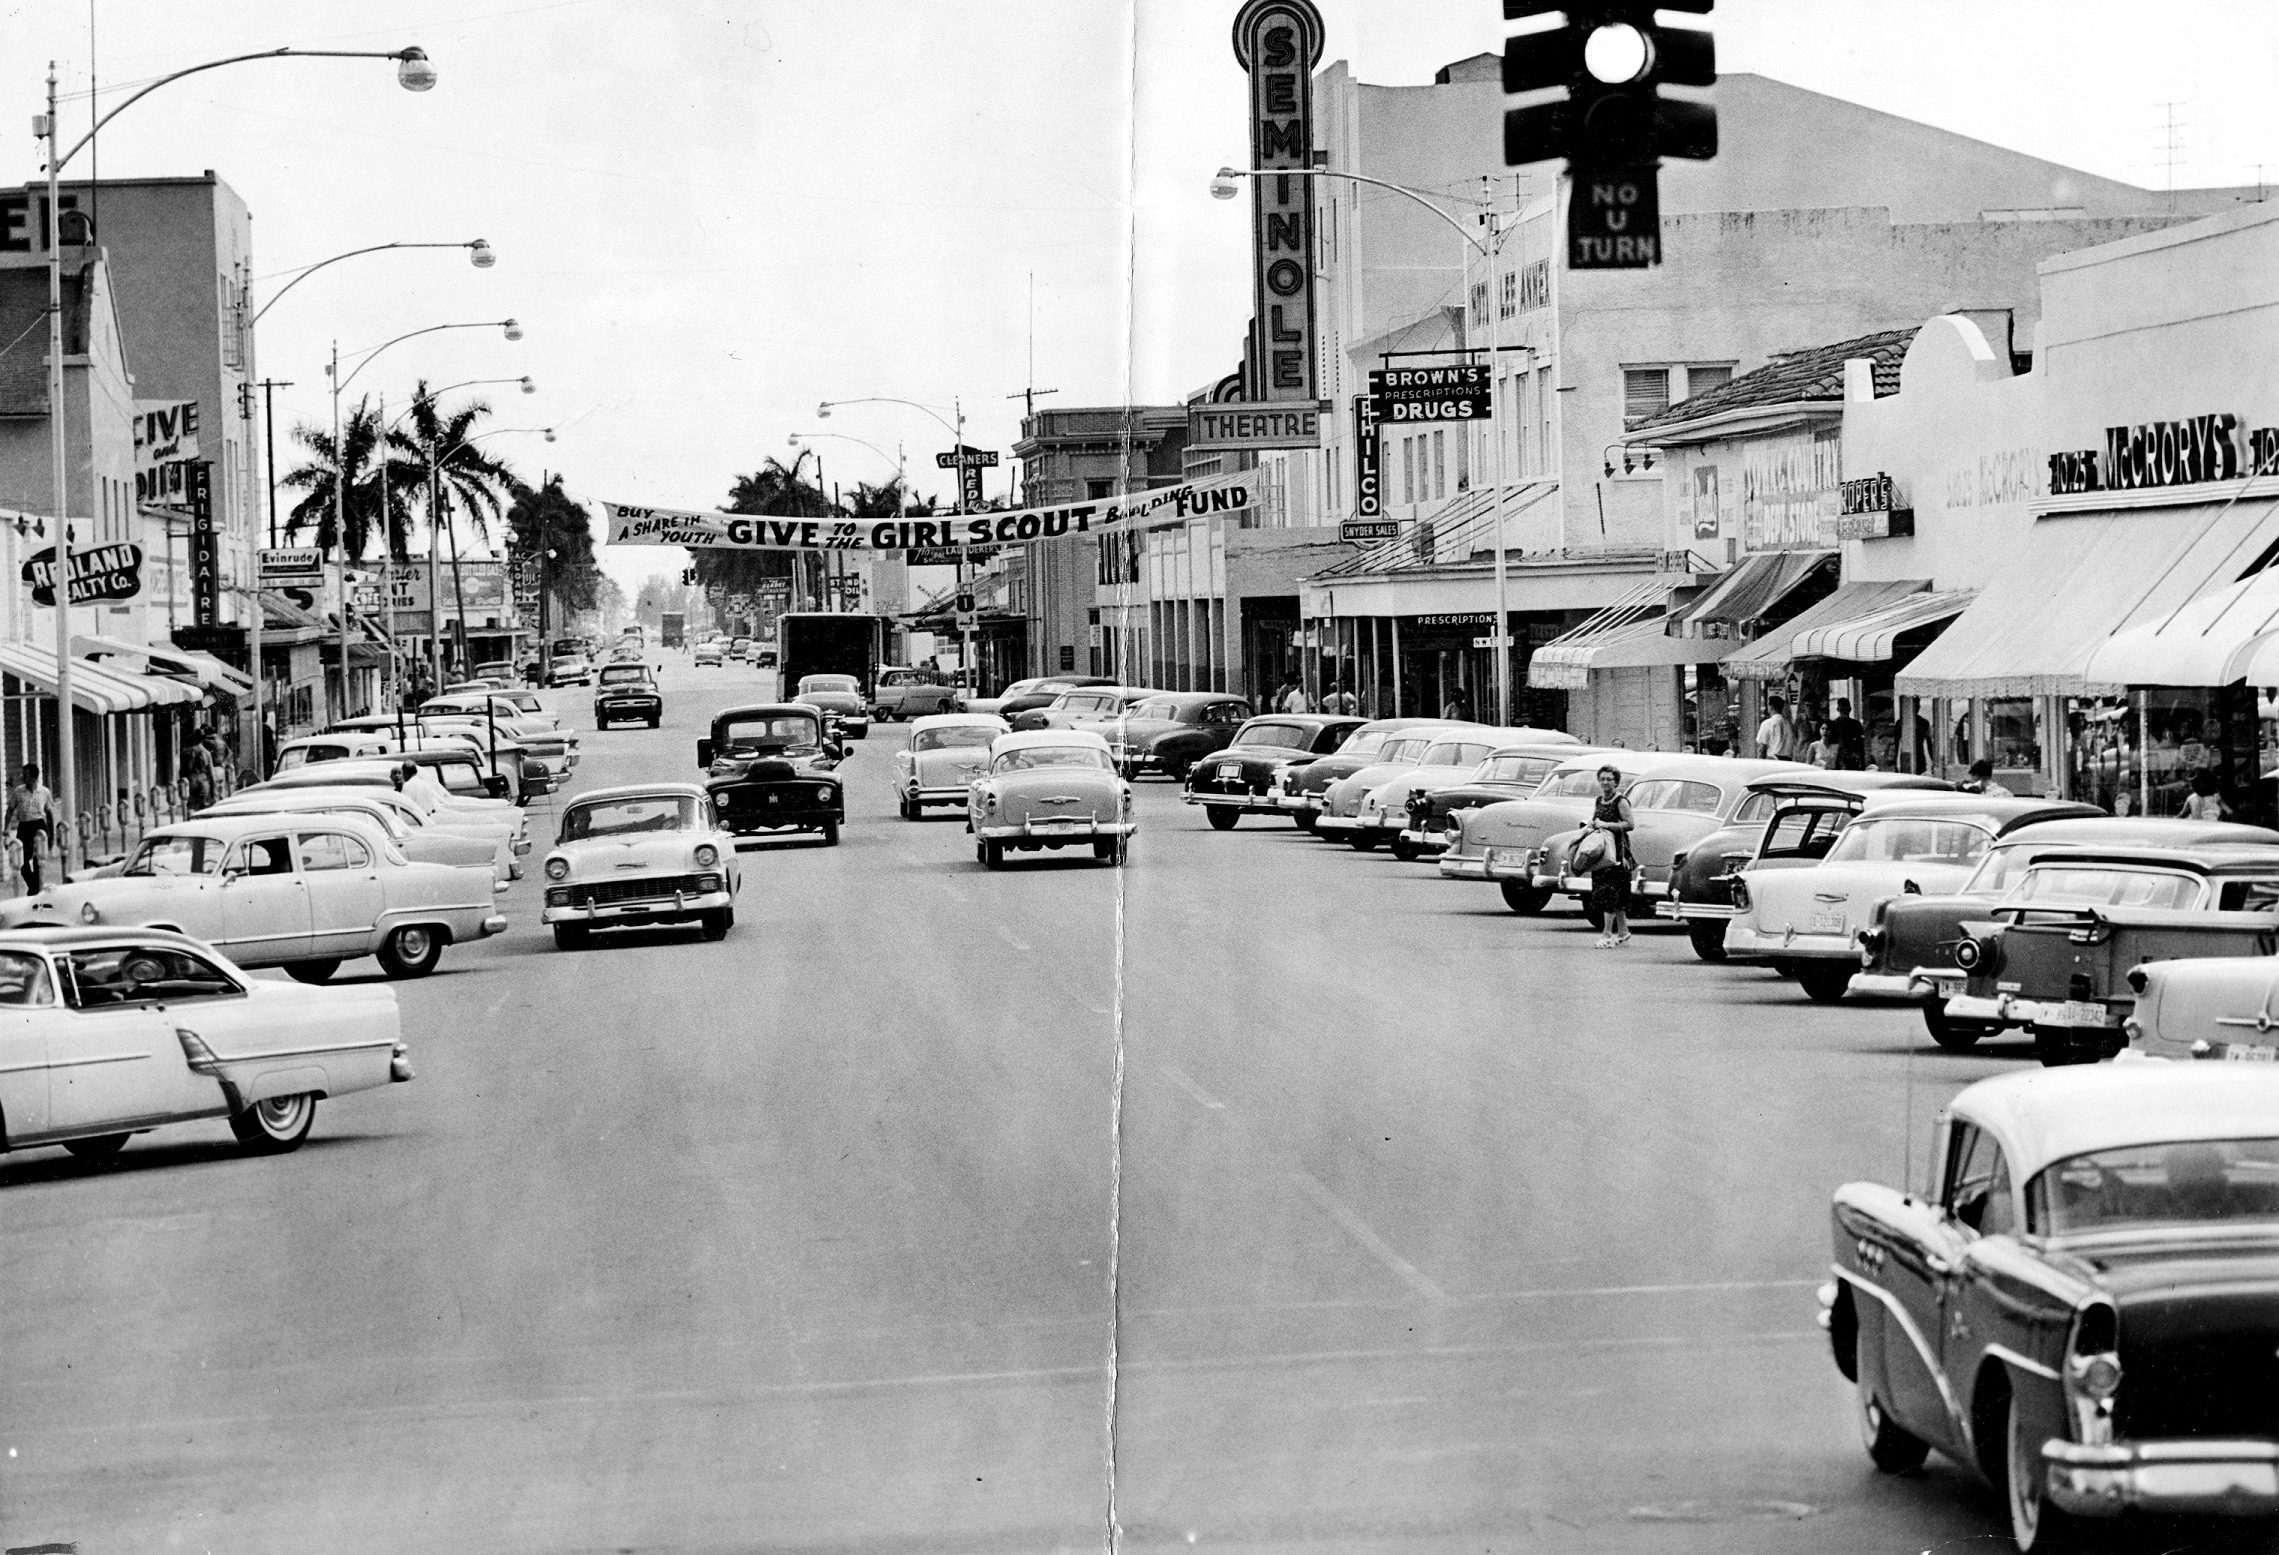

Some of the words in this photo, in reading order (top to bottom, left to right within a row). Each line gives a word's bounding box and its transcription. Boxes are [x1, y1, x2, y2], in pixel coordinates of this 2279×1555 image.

[1591, 183, 1639, 205] NO
[1263, 26, 1303, 388] SEMINOLE
[1606, 209, 1627, 231] U
[1577, 235, 1656, 264] TURN
[1385, 368, 1478, 386] BROWN'S
[1385, 386, 1481, 400] PRESCRIPTIONS
[1393, 400, 1473, 420] DRUGS
[1204, 412, 1316, 438] THEATRE
[153, 434, 180, 460] and
[1361, 400, 1378, 513] PHILCO
[939, 451, 998, 467] CLEANERS
[617, 506, 655, 519] BUY
[1176, 486, 1248, 518] FUND
[618, 526, 629, 541] A
[633, 516, 677, 537] SHARE
[684, 515, 701, 527] IN
[728, 520, 818, 547] GIVE
[833, 523, 856, 536] TO
[872, 520, 959, 549] GIRL
[968, 506, 1096, 545] SCOUT
[1344, 525, 1373, 537] SNYDER
[1375, 523, 1397, 536] SALES
[197, 472, 211, 625] FRIGIDAIRE
[825, 536, 864, 550] THE
[945, 545, 999, 555] LAUDERERS
[262, 552, 313, 564] Evinrude
[52, 576, 106, 602] ALTY
[111, 572, 132, 590] Co.
[957, 583, 973, 593] JCT
[964, 597, 968, 609] 1
[1418, 614, 1498, 626] PRESCRIPTIONS
[1787, 672, 1799, 705] ALE
